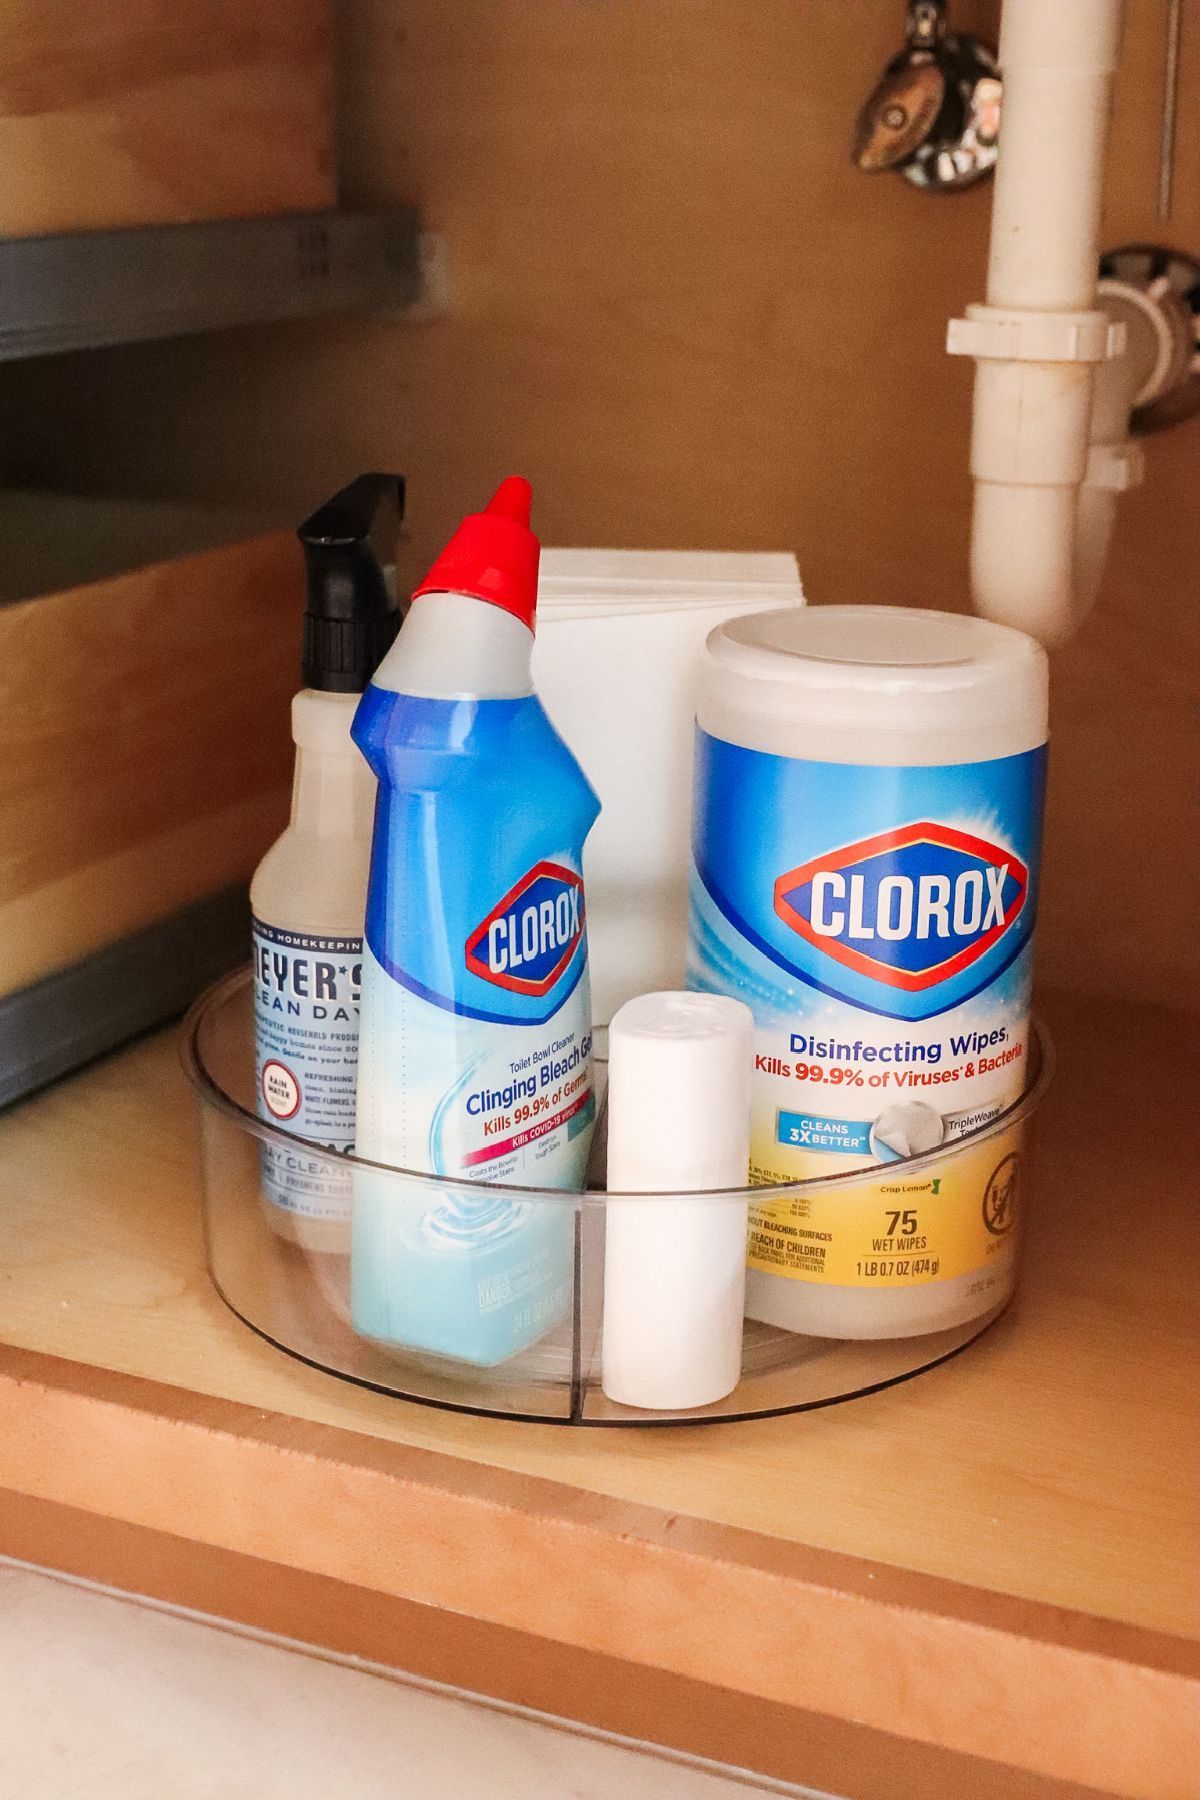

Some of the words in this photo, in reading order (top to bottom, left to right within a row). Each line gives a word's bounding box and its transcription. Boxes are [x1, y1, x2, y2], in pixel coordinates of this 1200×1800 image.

[810, 863, 1009, 941] CLOROX
[488, 883, 580, 974] CLOROX
[510, 1056, 531, 1074] Toilet
[532, 1045, 550, 1064] Bowl
[551, 1032, 575, 1055] Cleaner
[790, 1033, 942, 1064] Disinfecting
[755, 1054, 791, 1077] Kills
[795, 1062, 865, 1087] 99.9%
[868, 1071, 891, 1088] of
[964, 1062, 975, 1079] &
[978, 1042, 1023, 1074] Bacteria
[304, 1071, 354, 1083] REFRESHING
[466, 1074, 537, 1116] Clinging
[540, 1046, 580, 1087] Bleach
[267, 1083, 290, 1100] WATER
[484, 1115, 511, 1137] Kills
[514, 1094, 550, 1124] 99.9%
[552, 1088, 563, 1105] of
[512, 1132, 529, 1149] Kills
[529, 1113, 561, 1139] COVID-19
[789, 1127, 811, 1144] 3X
[801, 1120, 849, 1134] CLEANS
[469, 1165, 488, 1179] Coats
[488, 1162, 498, 1173] the
[880, 1186, 901, 1194] Crisp
[763, 1219, 798, 1237] BLEACHING
[799, 1228, 833, 1242] SURFACES
[885, 1210, 917, 1236] 75
[776, 1238, 785, 1250] OF
[786, 1241, 826, 1258] CHILDREN
[872, 1239, 895, 1252] WET
[896, 1236, 927, 1251] WIPES
[857, 1262, 862, 1275] 1
[865, 1262, 878, 1276] LB
[880, 1262, 895, 1276] 0.7
[896, 1261, 910, 1275] OZ
